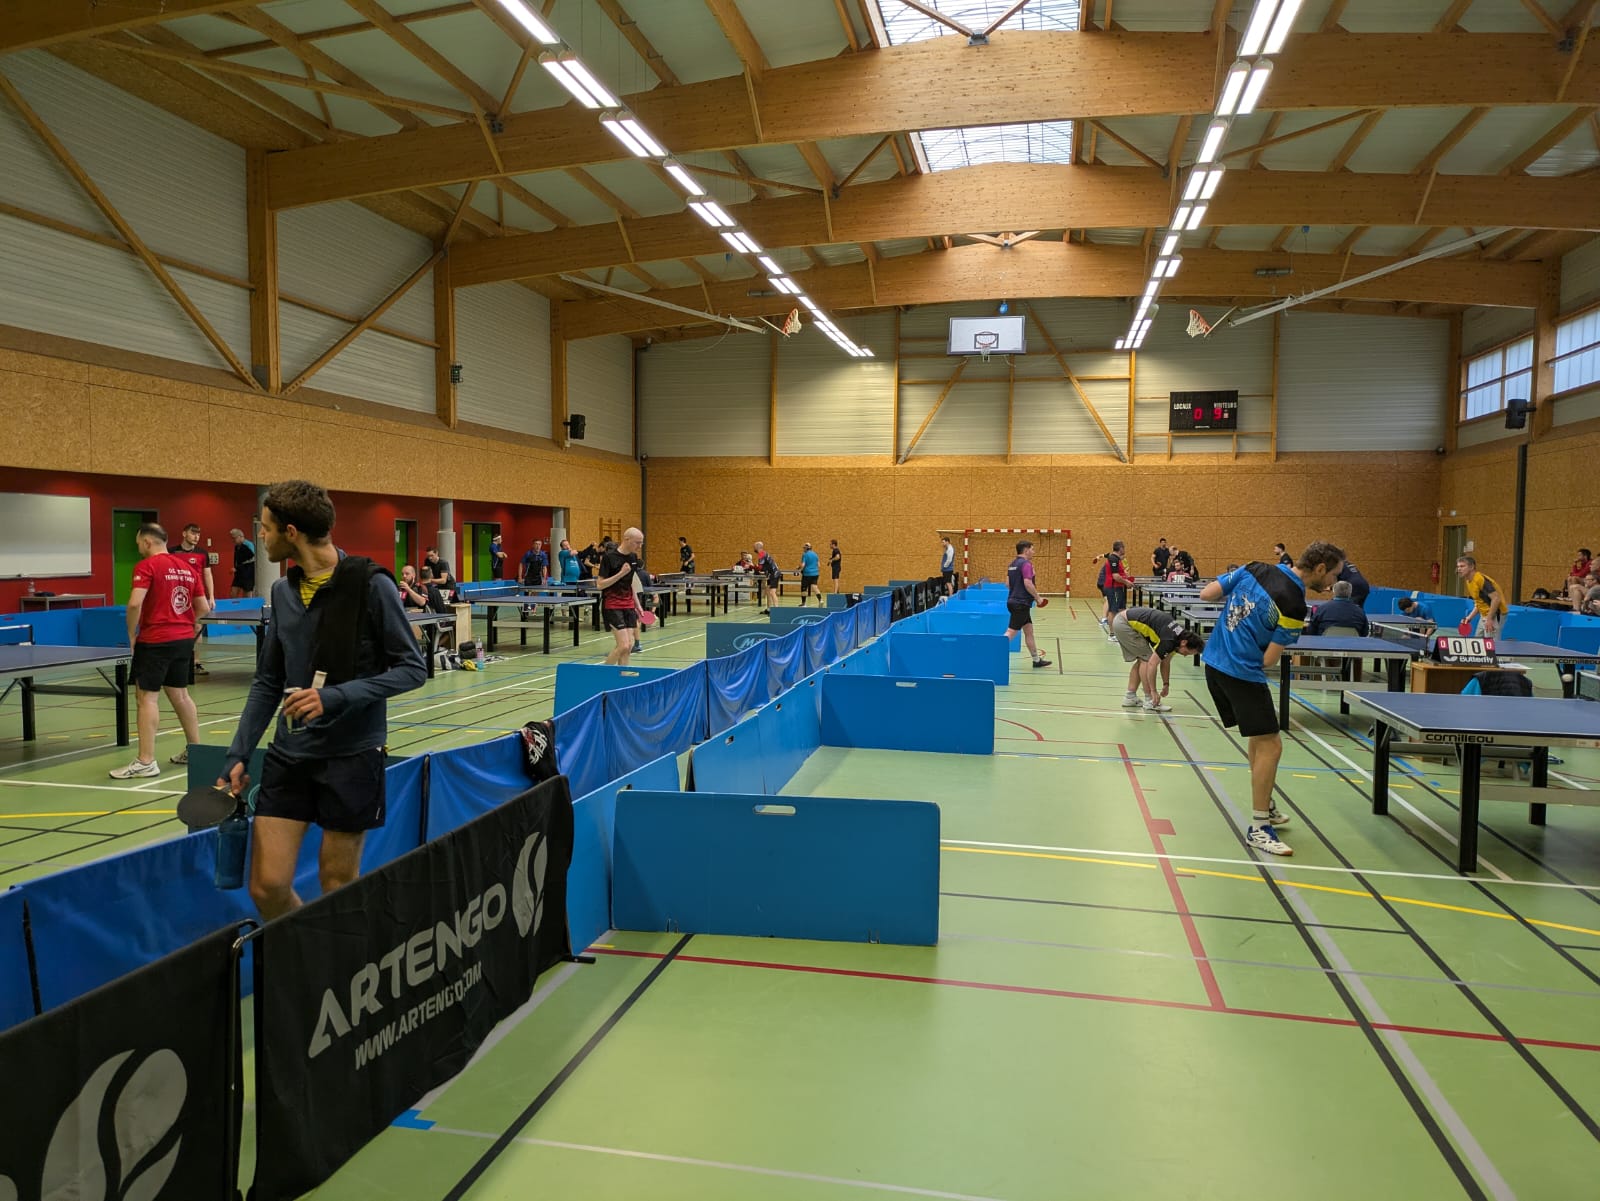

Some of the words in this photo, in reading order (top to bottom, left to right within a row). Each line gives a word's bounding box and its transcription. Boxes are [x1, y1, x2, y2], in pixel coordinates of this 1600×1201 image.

[1440, 640, 1446, 648] 0
[1453, 640, 1463, 654] 0
[1471, 640, 1482, 655] 0
[1486, 641, 1492, 650] 0
[1459, 655, 1493, 664] Butterfly
[308, 882, 507, 1059] ARTENGO
